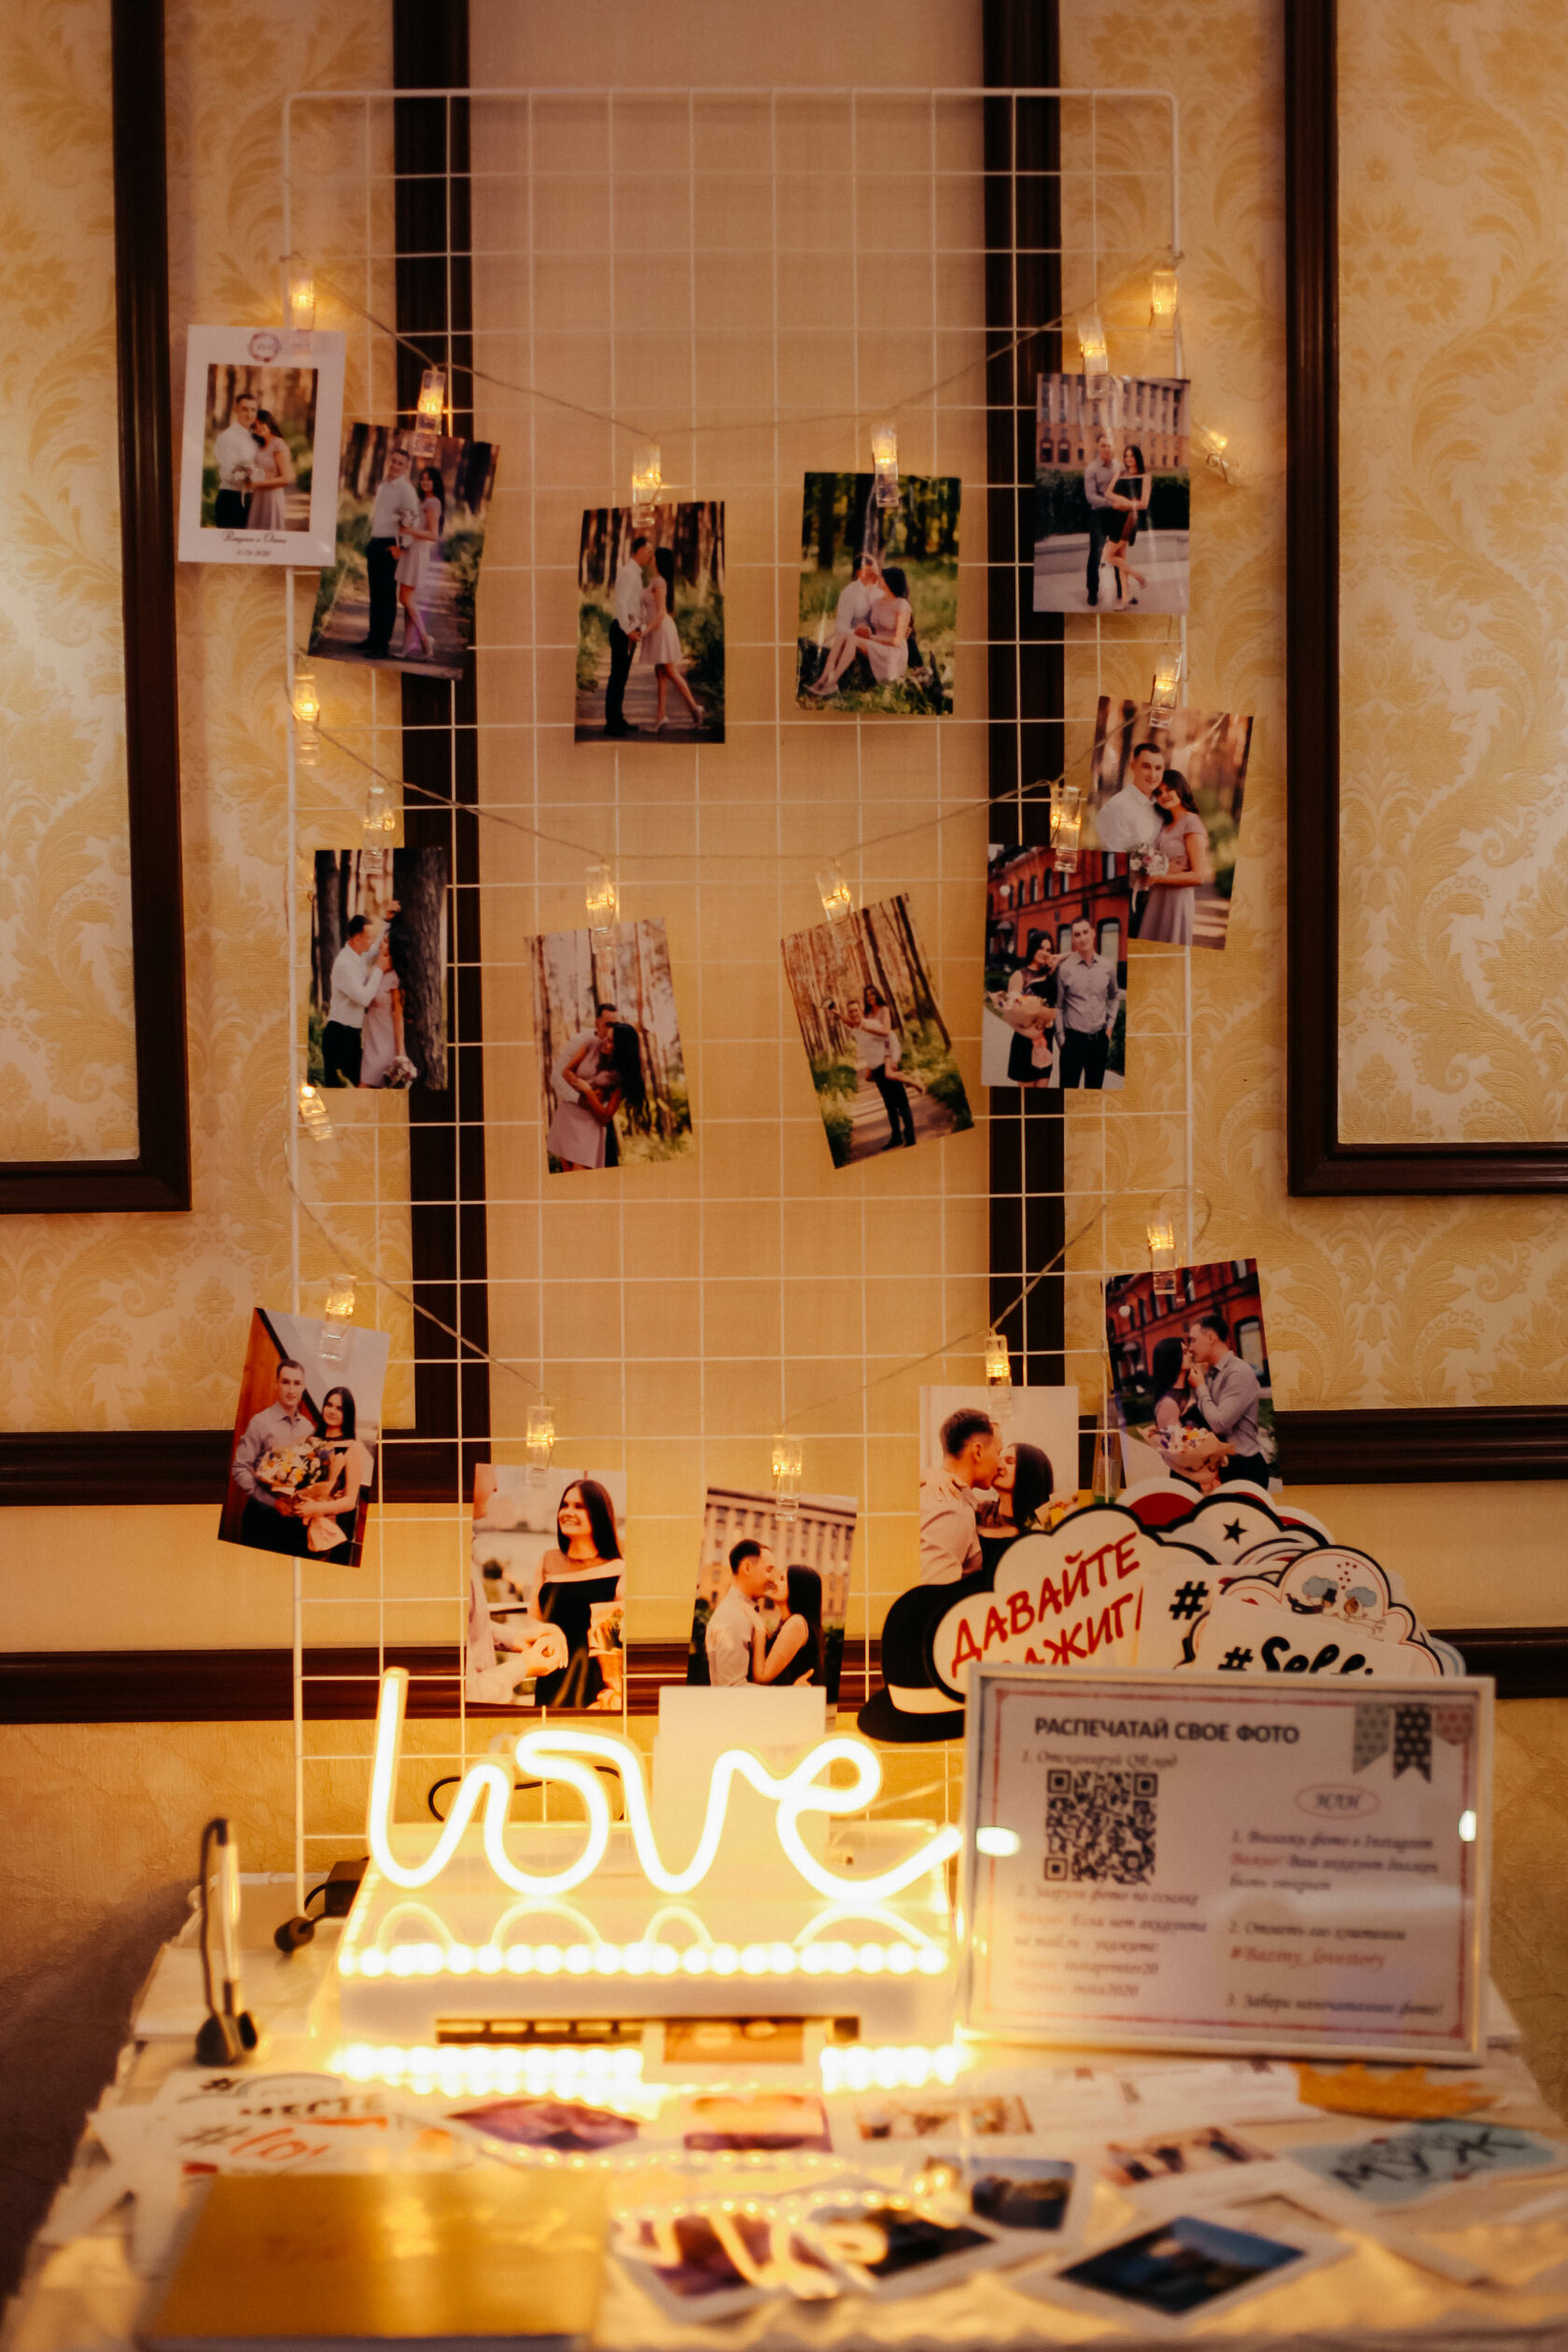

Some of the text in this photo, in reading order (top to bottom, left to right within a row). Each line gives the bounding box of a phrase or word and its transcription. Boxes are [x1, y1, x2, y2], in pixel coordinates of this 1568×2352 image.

[951, 1532, 1141, 1679] ДАВАЙТЕ
[1034, 1715, 1301, 1745] РАСПЕЧАТАЙ СВОЕ ФОТО
